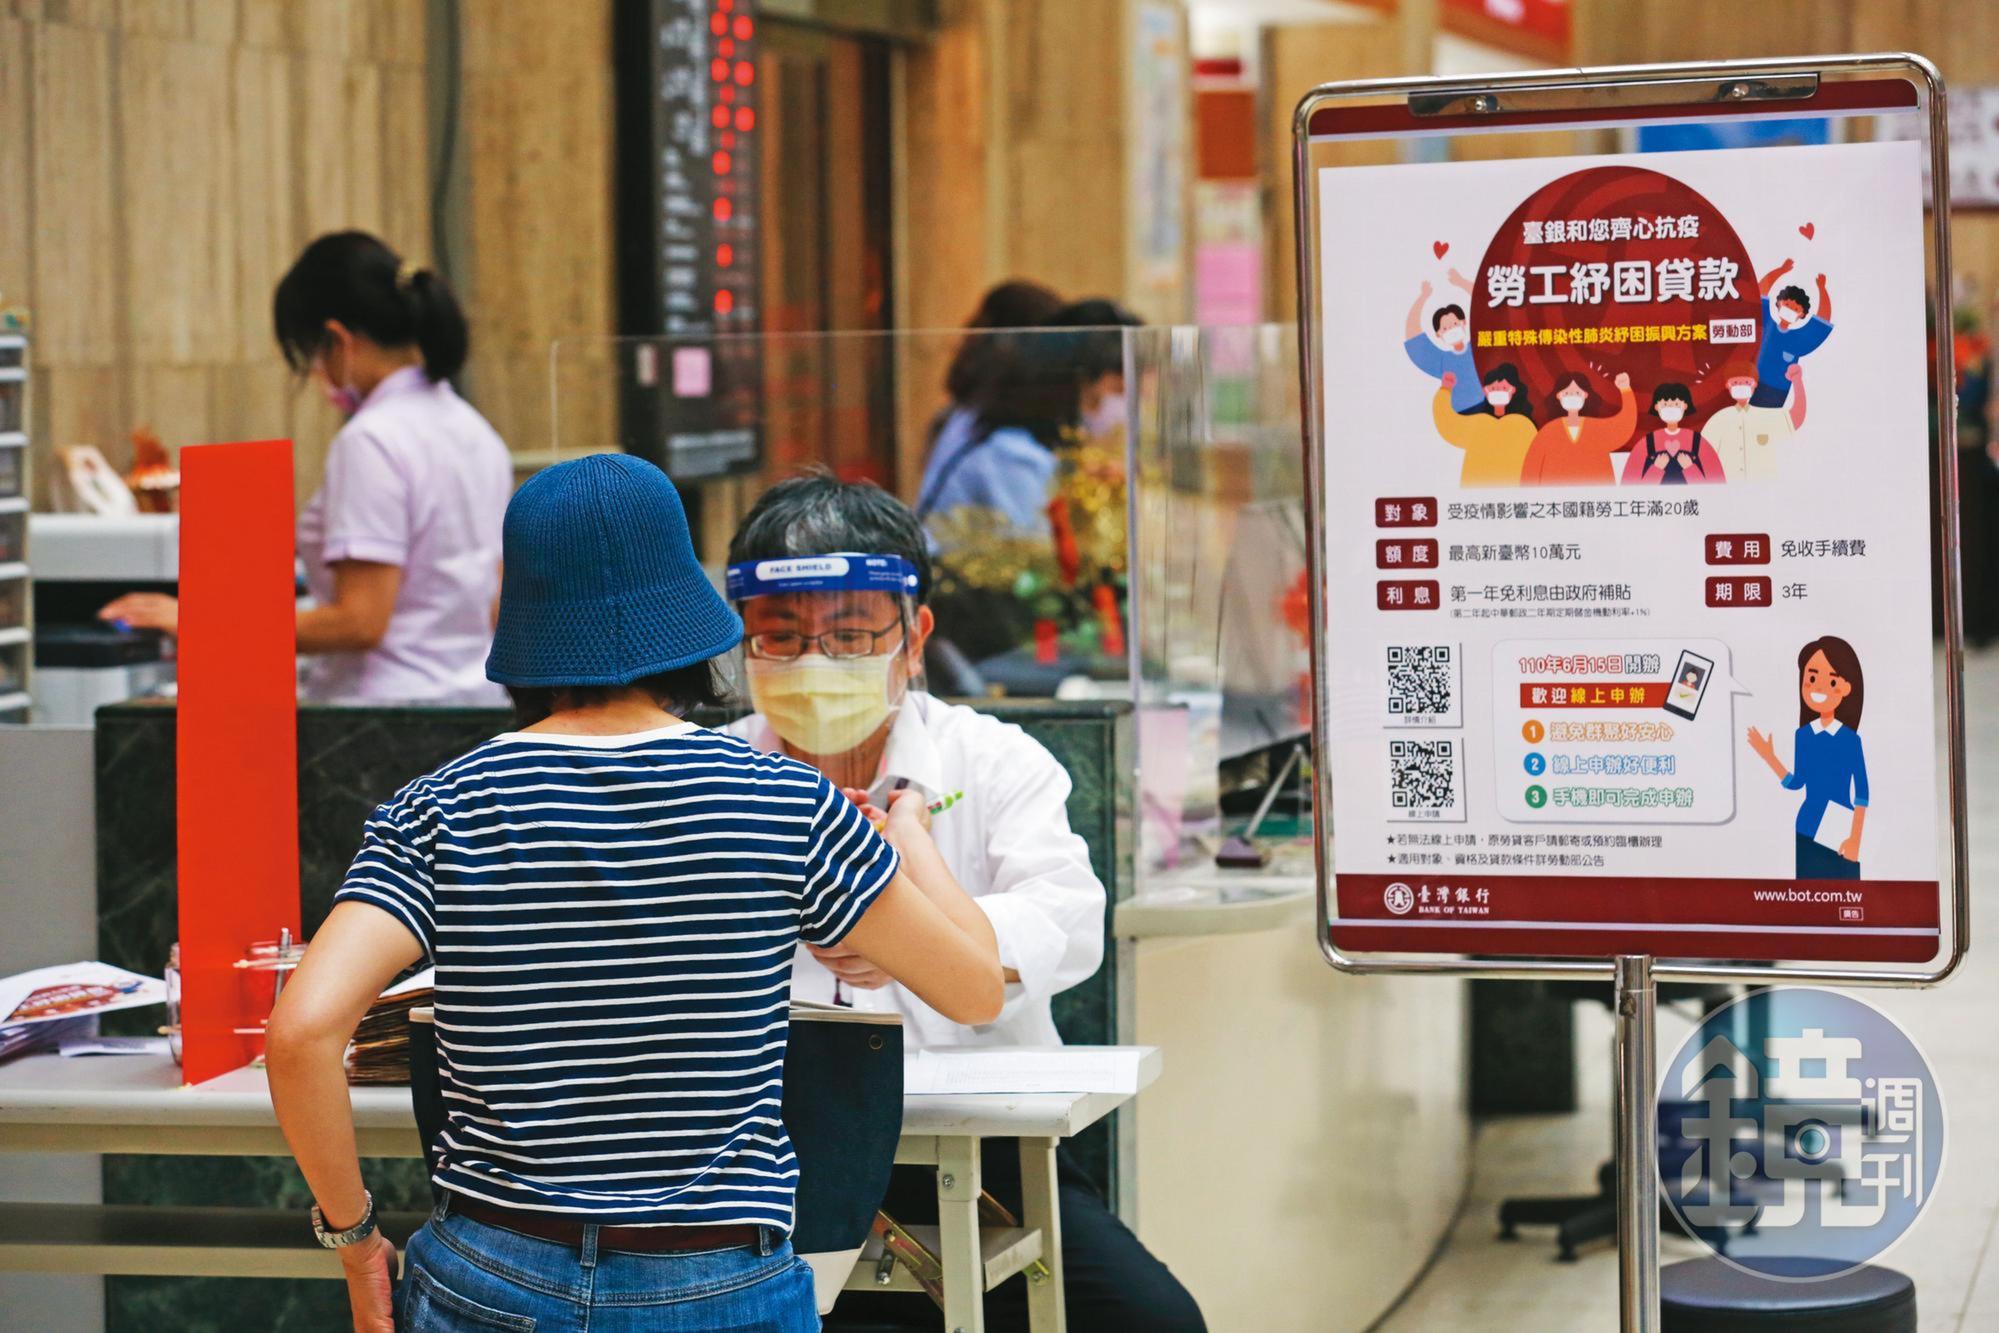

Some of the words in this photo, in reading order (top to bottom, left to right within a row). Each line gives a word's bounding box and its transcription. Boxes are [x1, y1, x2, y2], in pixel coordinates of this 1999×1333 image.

[1523, 215, 1699, 245] 臺銀和您齊心抗疫
[1487, 256, 1740, 308] 勞工紓困貸款
[1477, 324, 1707, 347] 嚴重特殊傳染性肺炎紓困振興方案
[1712, 323, 1752, 338] 勞動部
[1384, 503, 1429, 521] 對象
[1447, 499, 1700, 520] 受疫情影響之本國籍勞工年滿20歲
[1385, 545, 1430, 563] 額度
[1448, 543, 1582, 561] 最高新臺幣10萬元
[1715, 540, 1760, 559] 費用
[1781, 539, 1866, 558] 免收手續費
[769, 565, 792, 573] FACE
[796, 563, 832, 572] SHIELD
[1386, 587, 1431, 605] 利息
[1450, 584, 1632, 602] 第一年免利息由政府補貼
[1715, 583, 1761, 601] 期限
[1782, 582, 1808, 600] 3年
[1531, 687, 1645, 704] 歡迎線上申辦
[1551, 722, 1675, 742] 避免群聚好安心
[1552, 754, 1675, 775] 線上申辦好便利
[1553, 787, 1694, 808] 手機即可完成申辦
[1417, 884, 1490, 904] 臺灣銀行
[1753, 888, 1862, 903] www.bot.com.tw
[1418, 906, 1440, 914] BANK
[1458, 907, 1490, 915] TAIWAN
